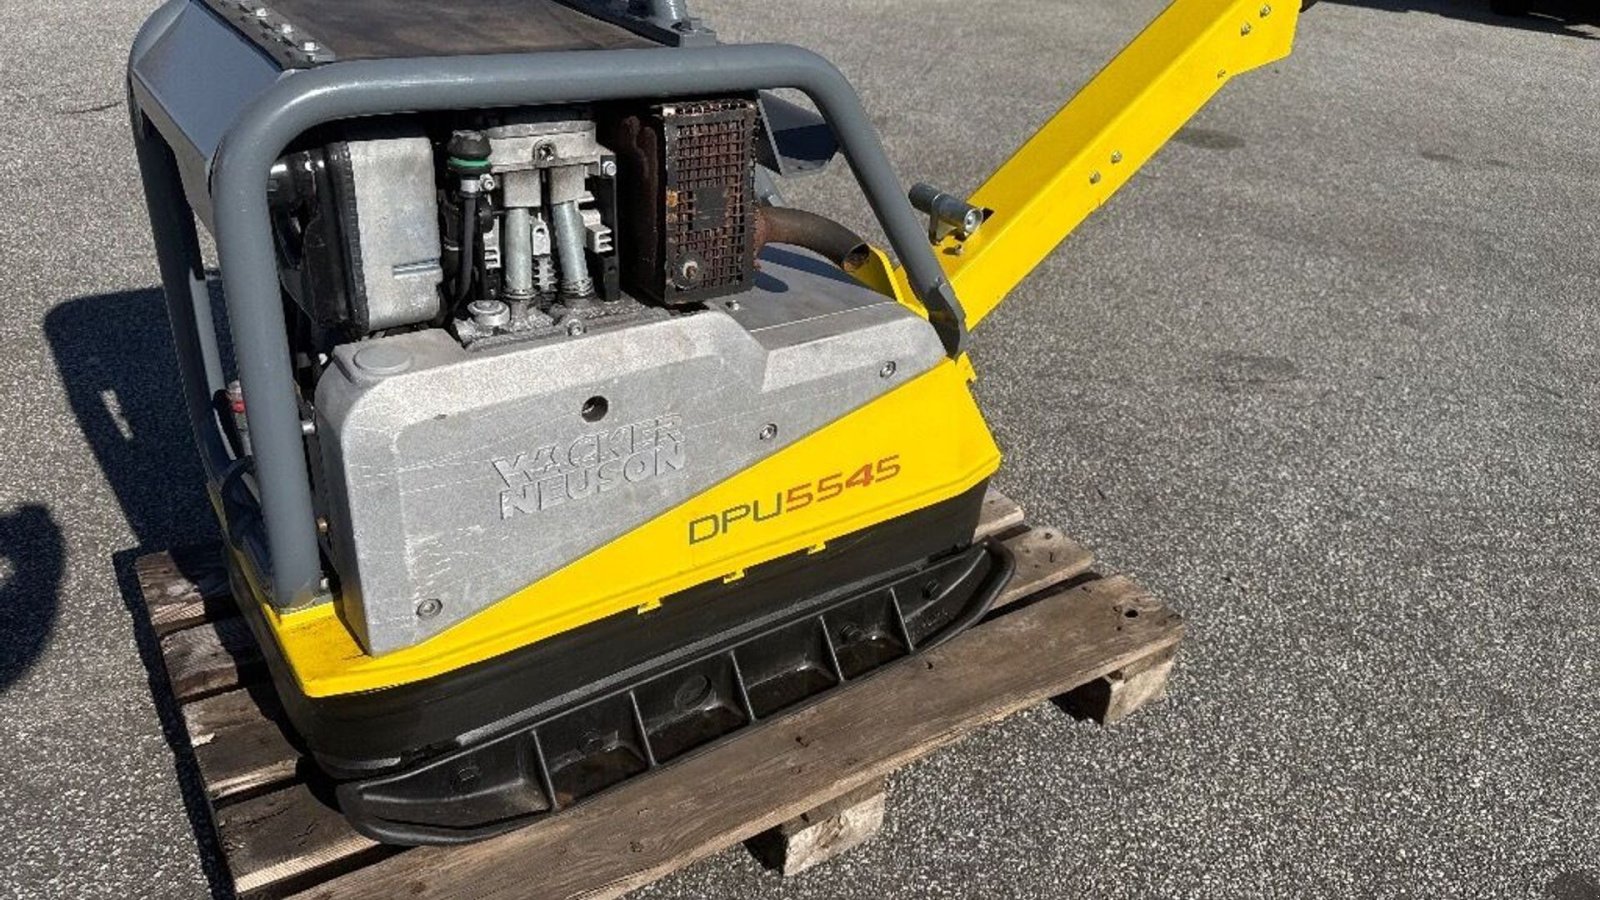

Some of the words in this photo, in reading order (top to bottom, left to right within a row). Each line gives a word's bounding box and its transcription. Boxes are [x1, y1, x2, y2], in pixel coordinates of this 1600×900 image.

[491, 413, 685, 487] WACKER
[500, 443, 685, 520] NEUSON
[689, 454, 901, 545] DPU5545
